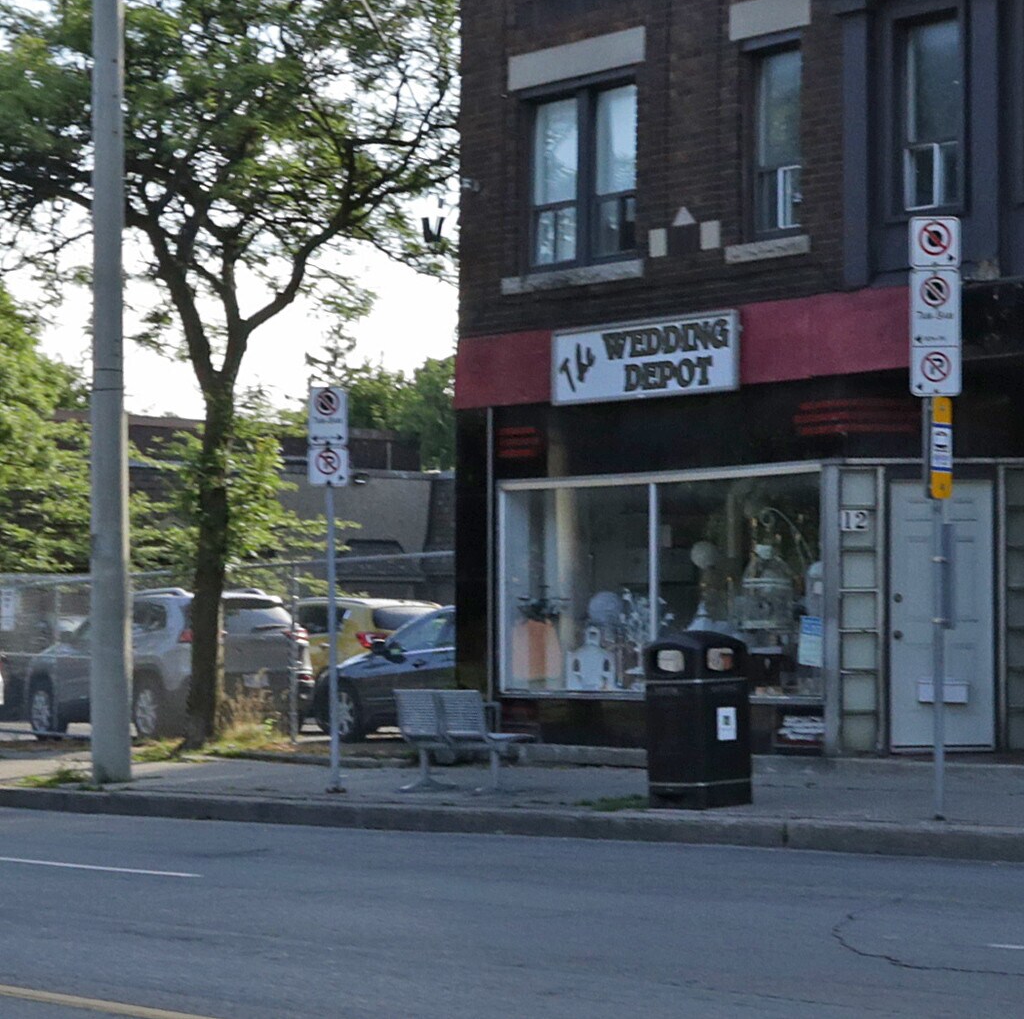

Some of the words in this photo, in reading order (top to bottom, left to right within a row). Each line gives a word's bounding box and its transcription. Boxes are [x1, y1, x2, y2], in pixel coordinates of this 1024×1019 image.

[601, 318, 729, 360] WEDDING
[623, 356, 713, 392] DEPOT
[844, 511, 868, 530] 12
